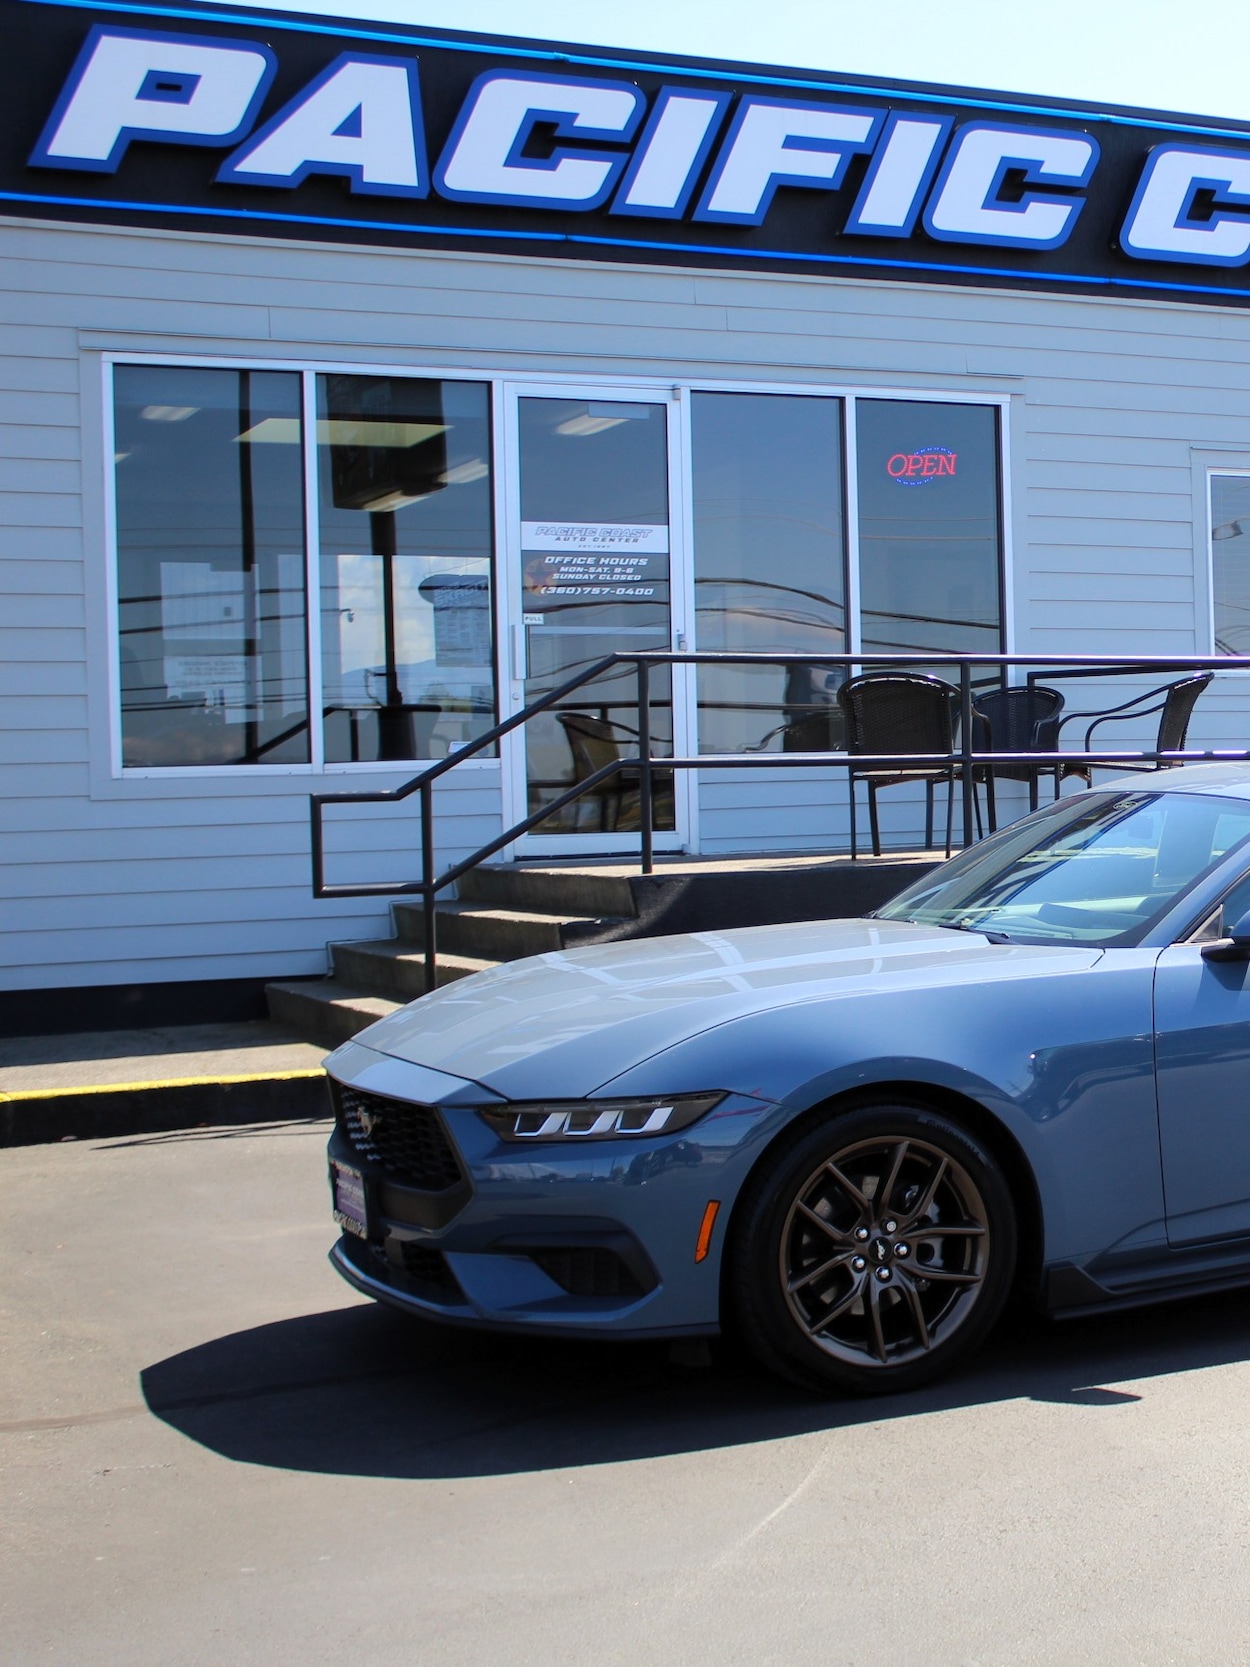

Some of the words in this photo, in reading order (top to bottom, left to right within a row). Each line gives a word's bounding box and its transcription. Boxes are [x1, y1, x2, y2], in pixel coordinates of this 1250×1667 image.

[28, 24, 1100, 250] PACIFIC
[886, 453, 957, 477] OPEN
[535, 526, 598, 537] PACIFIC
[599, 527, 653, 539] COAST
[544, 556, 596, 565] OFFICE
[599, 557, 649, 566] HOURS
[540, 586, 654, 596] (360)757-0400
